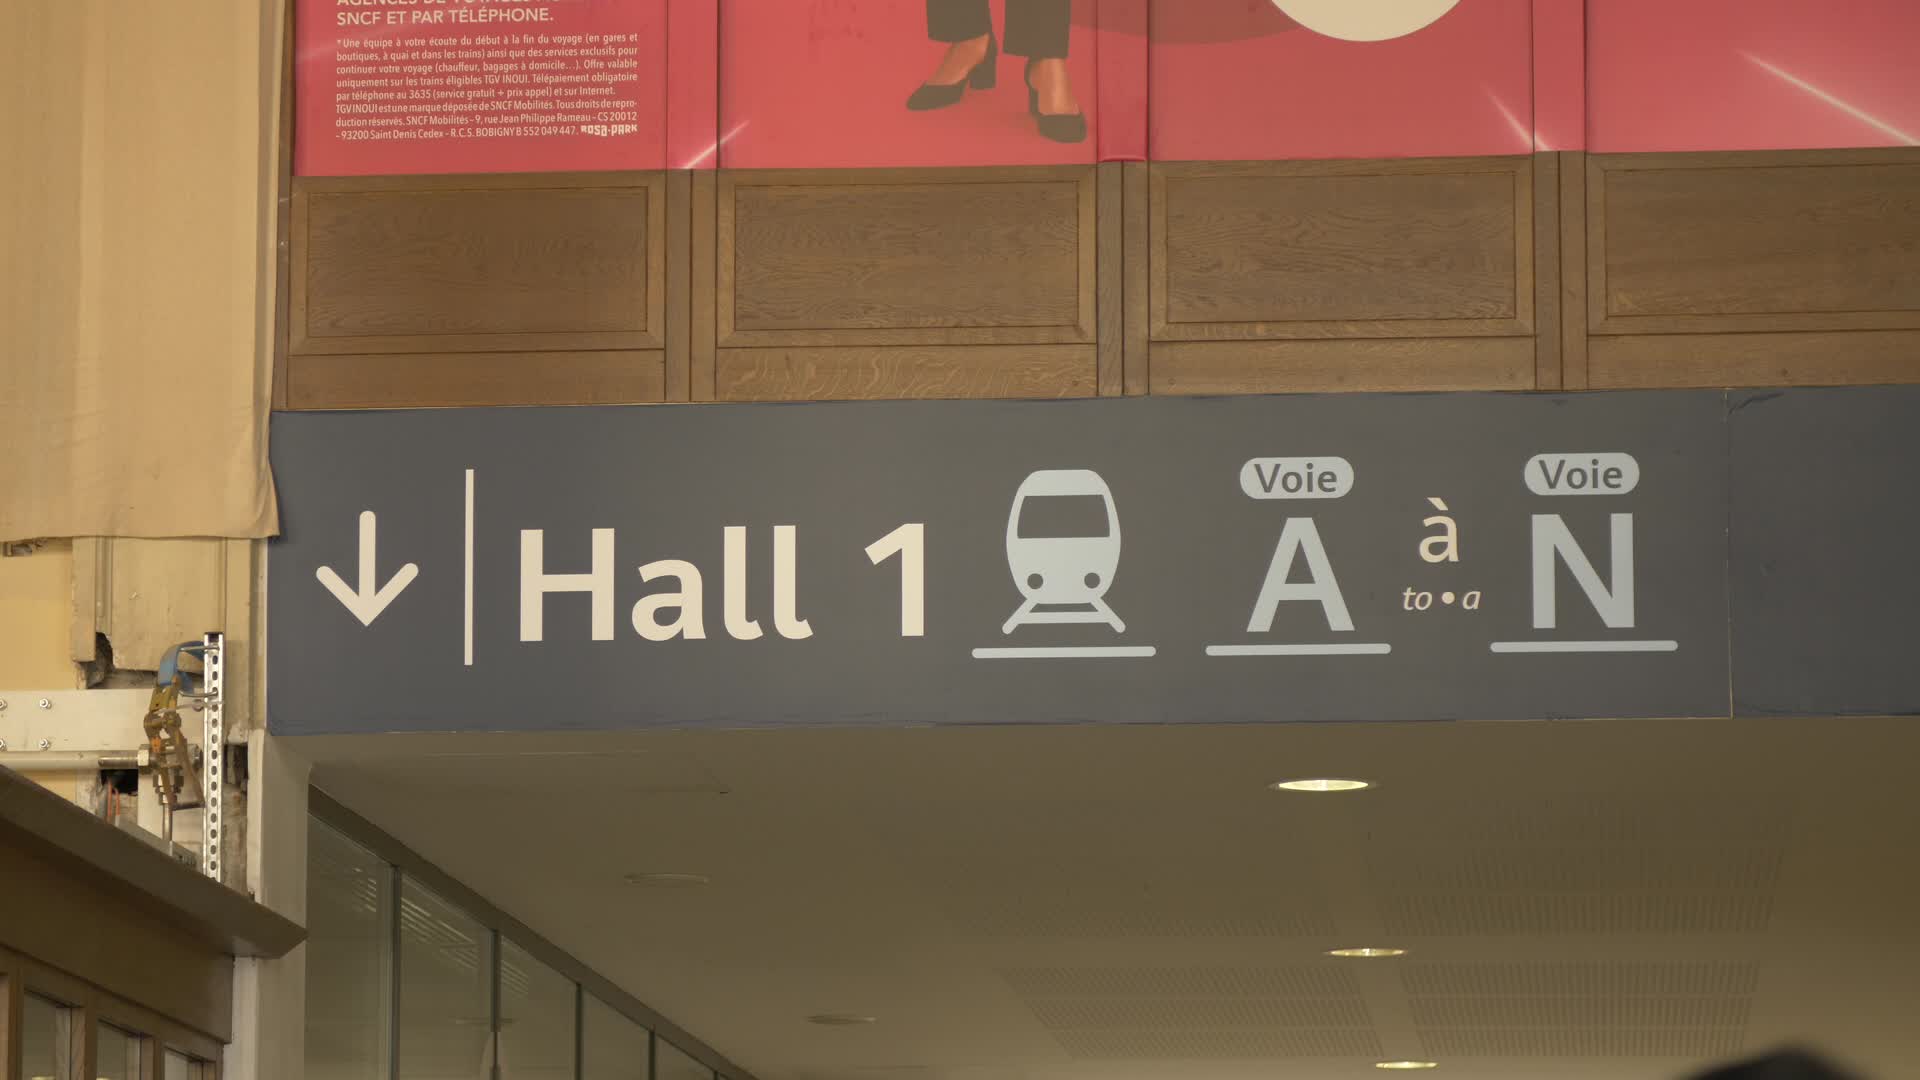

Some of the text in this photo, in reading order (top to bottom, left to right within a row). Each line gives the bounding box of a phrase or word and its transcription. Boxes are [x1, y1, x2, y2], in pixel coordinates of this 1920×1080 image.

[337, 7, 553, 25] SNCF ET PAR TÉLÉPHONE.
[364, 37, 393, 50] équipe
[396, 37, 401, 47] à
[405, 36, 426, 47] votre
[429, 36, 457, 46] écoute
[461, 36, 472, 46] du
[476, 35, 500, 45] début
[503, 35, 509, 45] à
[512, 35, 520, 45] la
[523, 34, 534, 45] fin
[538, 34, 549, 44] du
[553, 35, 582, 46] voyage
[586, 33, 600, 45] (en
[603, 34, 626, 45] gares
[629, 33, 638, 42] et
[383, 50, 388, 60] à
[390, 50, 409, 62] quai
[411, 50, 420, 60] et
[422, 49, 442, 60] dans
[444, 49, 456, 59] les
[458, 48, 485, 61] trains)
[487, 48, 507, 58] ainsi
[509, 49, 525, 60] que
[528, 47, 542, 58] des
[545, 47, 578, 57] services
[580, 46, 615, 57] exclusifs
[618, 47, 638, 58] pour
[336, 63, 376, 74] continuer
[379, 63, 400, 73] votre
[403, 64, 433, 75] voyage
[483, 61, 518, 73] bagages
[521, 61, 526, 71] à
[584, 59, 604, 69] Offre
[607, 58, 637, 69] valable
[336, 76, 388, 89] uniquement
[390, 78, 403, 86] sur
[406, 76, 417, 86] les
[420, 75, 443, 86] trains
[446, 74, 482, 87] éligibles
[485, 74, 500, 84] TGV
[533, 72, 589, 85] Télépaiement
[592, 71, 637, 84] obligatoire
[336, 92, 349, 102] par
[352, 89, 394, 102] téléphone
[396, 91, 406, 99] au
[409, 89, 431, 99] 3635
[433, 88, 465, 101] (service
[467, 87, 495, 100] gratuit
[507, 87, 523, 99] prix
[525, 86, 552, 99] appel)
[554, 87, 561, 96] et
[564, 88, 577, 96] sur
[336, 103, 351, 114] TGV
[352, 103, 377, 113] INOUI
[379, 103, 391, 113] est
[392, 104, 407, 113] une
[409, 104, 441, 114] marque
[442, 101, 477, 114] déposée
[479, 101, 489, 111] de
[491, 100, 512, 111] SNCF
[556, 99, 578, 109] Tous
[578, 99, 599, 109] droits
[601, 98, 610, 109] de
[336, 117, 367, 127] duction
[406, 115, 428, 126] SNCF
[429, 115, 469, 125] Mobilités
[484, 116, 498, 124] rue
[500, 114, 519, 124] Jean
[521, 113, 555, 126] Philippe
[557, 112, 591, 123] Rameau
[598, 112, 608, 122] CS
[610, 111, 637, 122] 20012
[341, 130, 369, 140] 93200
[370, 129, 391, 140] Saint
[393, 129, 416, 139] Denis
[418, 128, 443, 139] Cedex
[476, 127, 514, 138] BOBIGNY
[516, 127, 522, 137] B
[523, 126, 539, 137] 552
[541, 126, 558, 136] 049
[1254, 463, 1338, 493] Voie
[1539, 459, 1623, 490] Voie
[1419, 497, 1460, 563] à
[1246, 517, 1355, 632] A
[1532, 513, 1635, 629] N
[520, 523, 924, 642] Hall 1
[1402, 587, 1481, 611] to a
